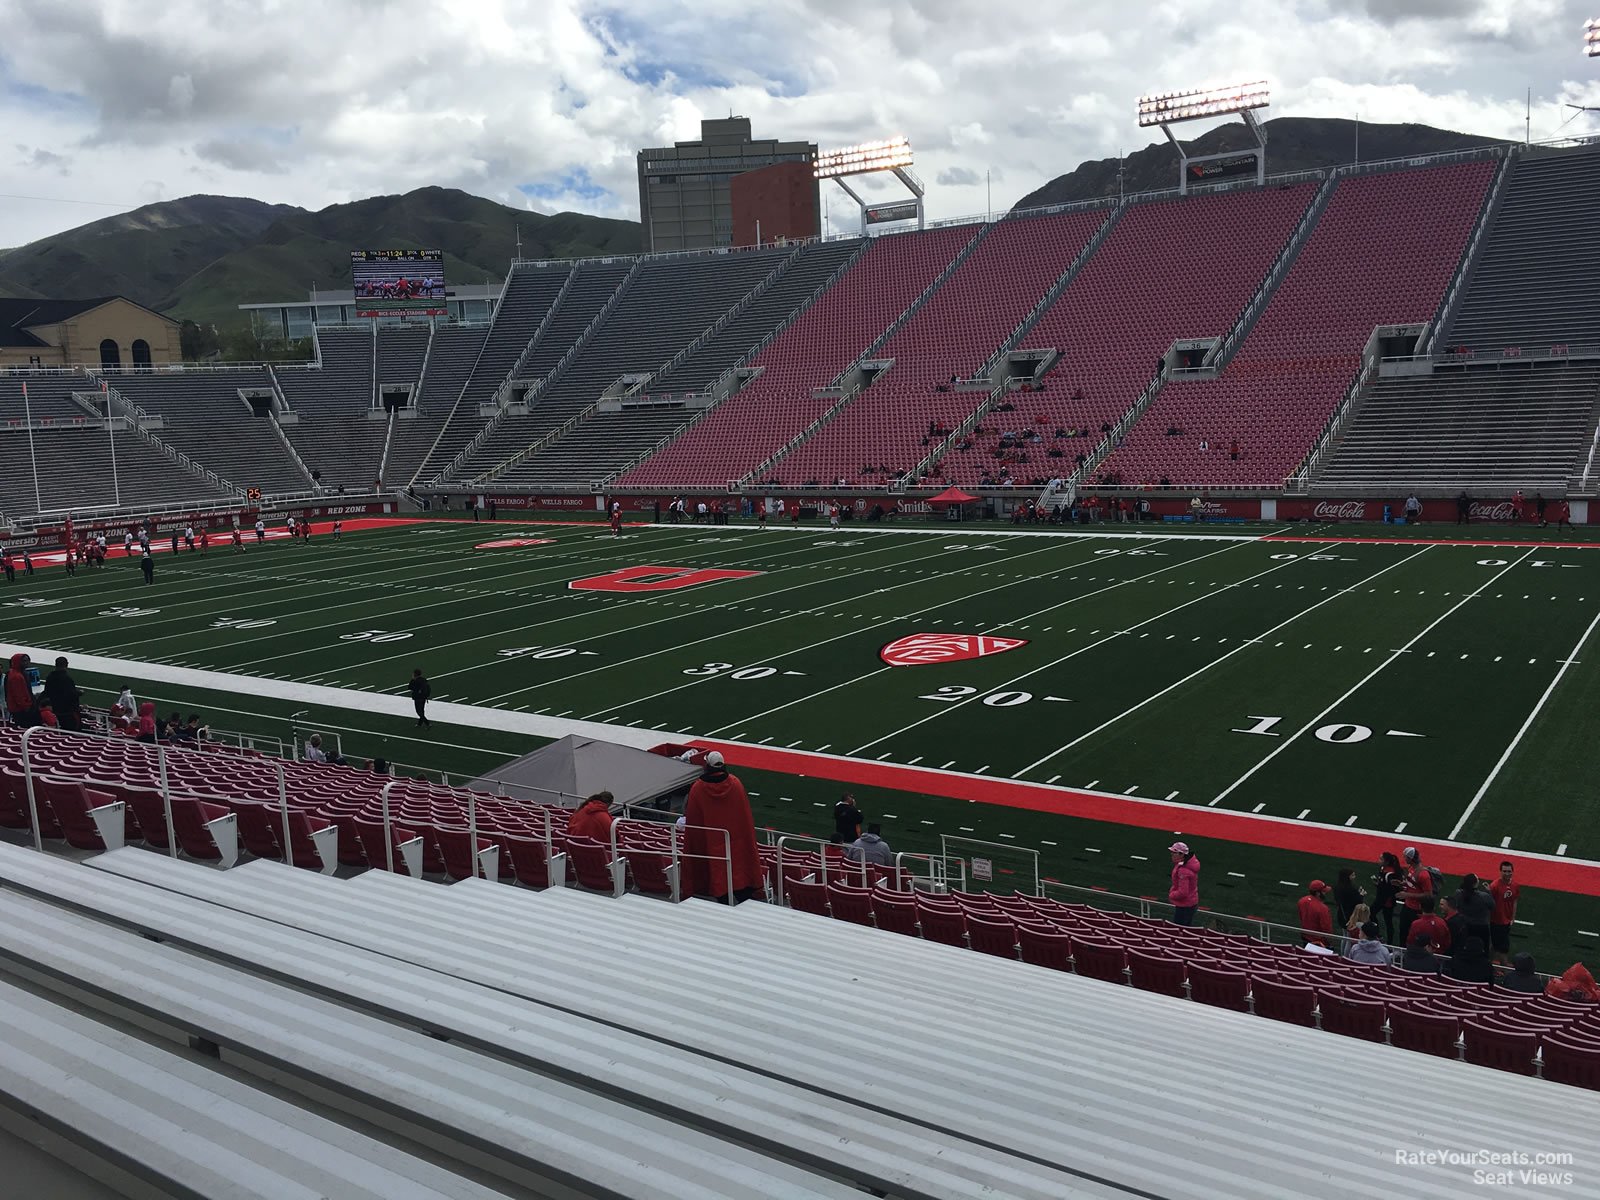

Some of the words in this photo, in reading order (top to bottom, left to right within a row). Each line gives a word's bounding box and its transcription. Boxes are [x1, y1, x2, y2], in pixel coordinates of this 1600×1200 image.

[1395, 327, 1408, 336] 37
[248, 489, 261, 499] 25
[344, 505, 367, 513] ZONE
[897, 499, 933, 514] Smith's
[1313, 501, 1367, 518] Coca-Cola
[257, 511, 289, 519] University
[156, 521, 192, 529] University
[86, 531, 104, 540] RED
[106, 528, 128, 537] ZONE
[338, 629, 414, 643] 50
[496, 645, 577, 660] 40
[682, 662, 778, 680] 30
[918, 685, 1033, 707] 20
[1231, 715, 1373, 743] 10
